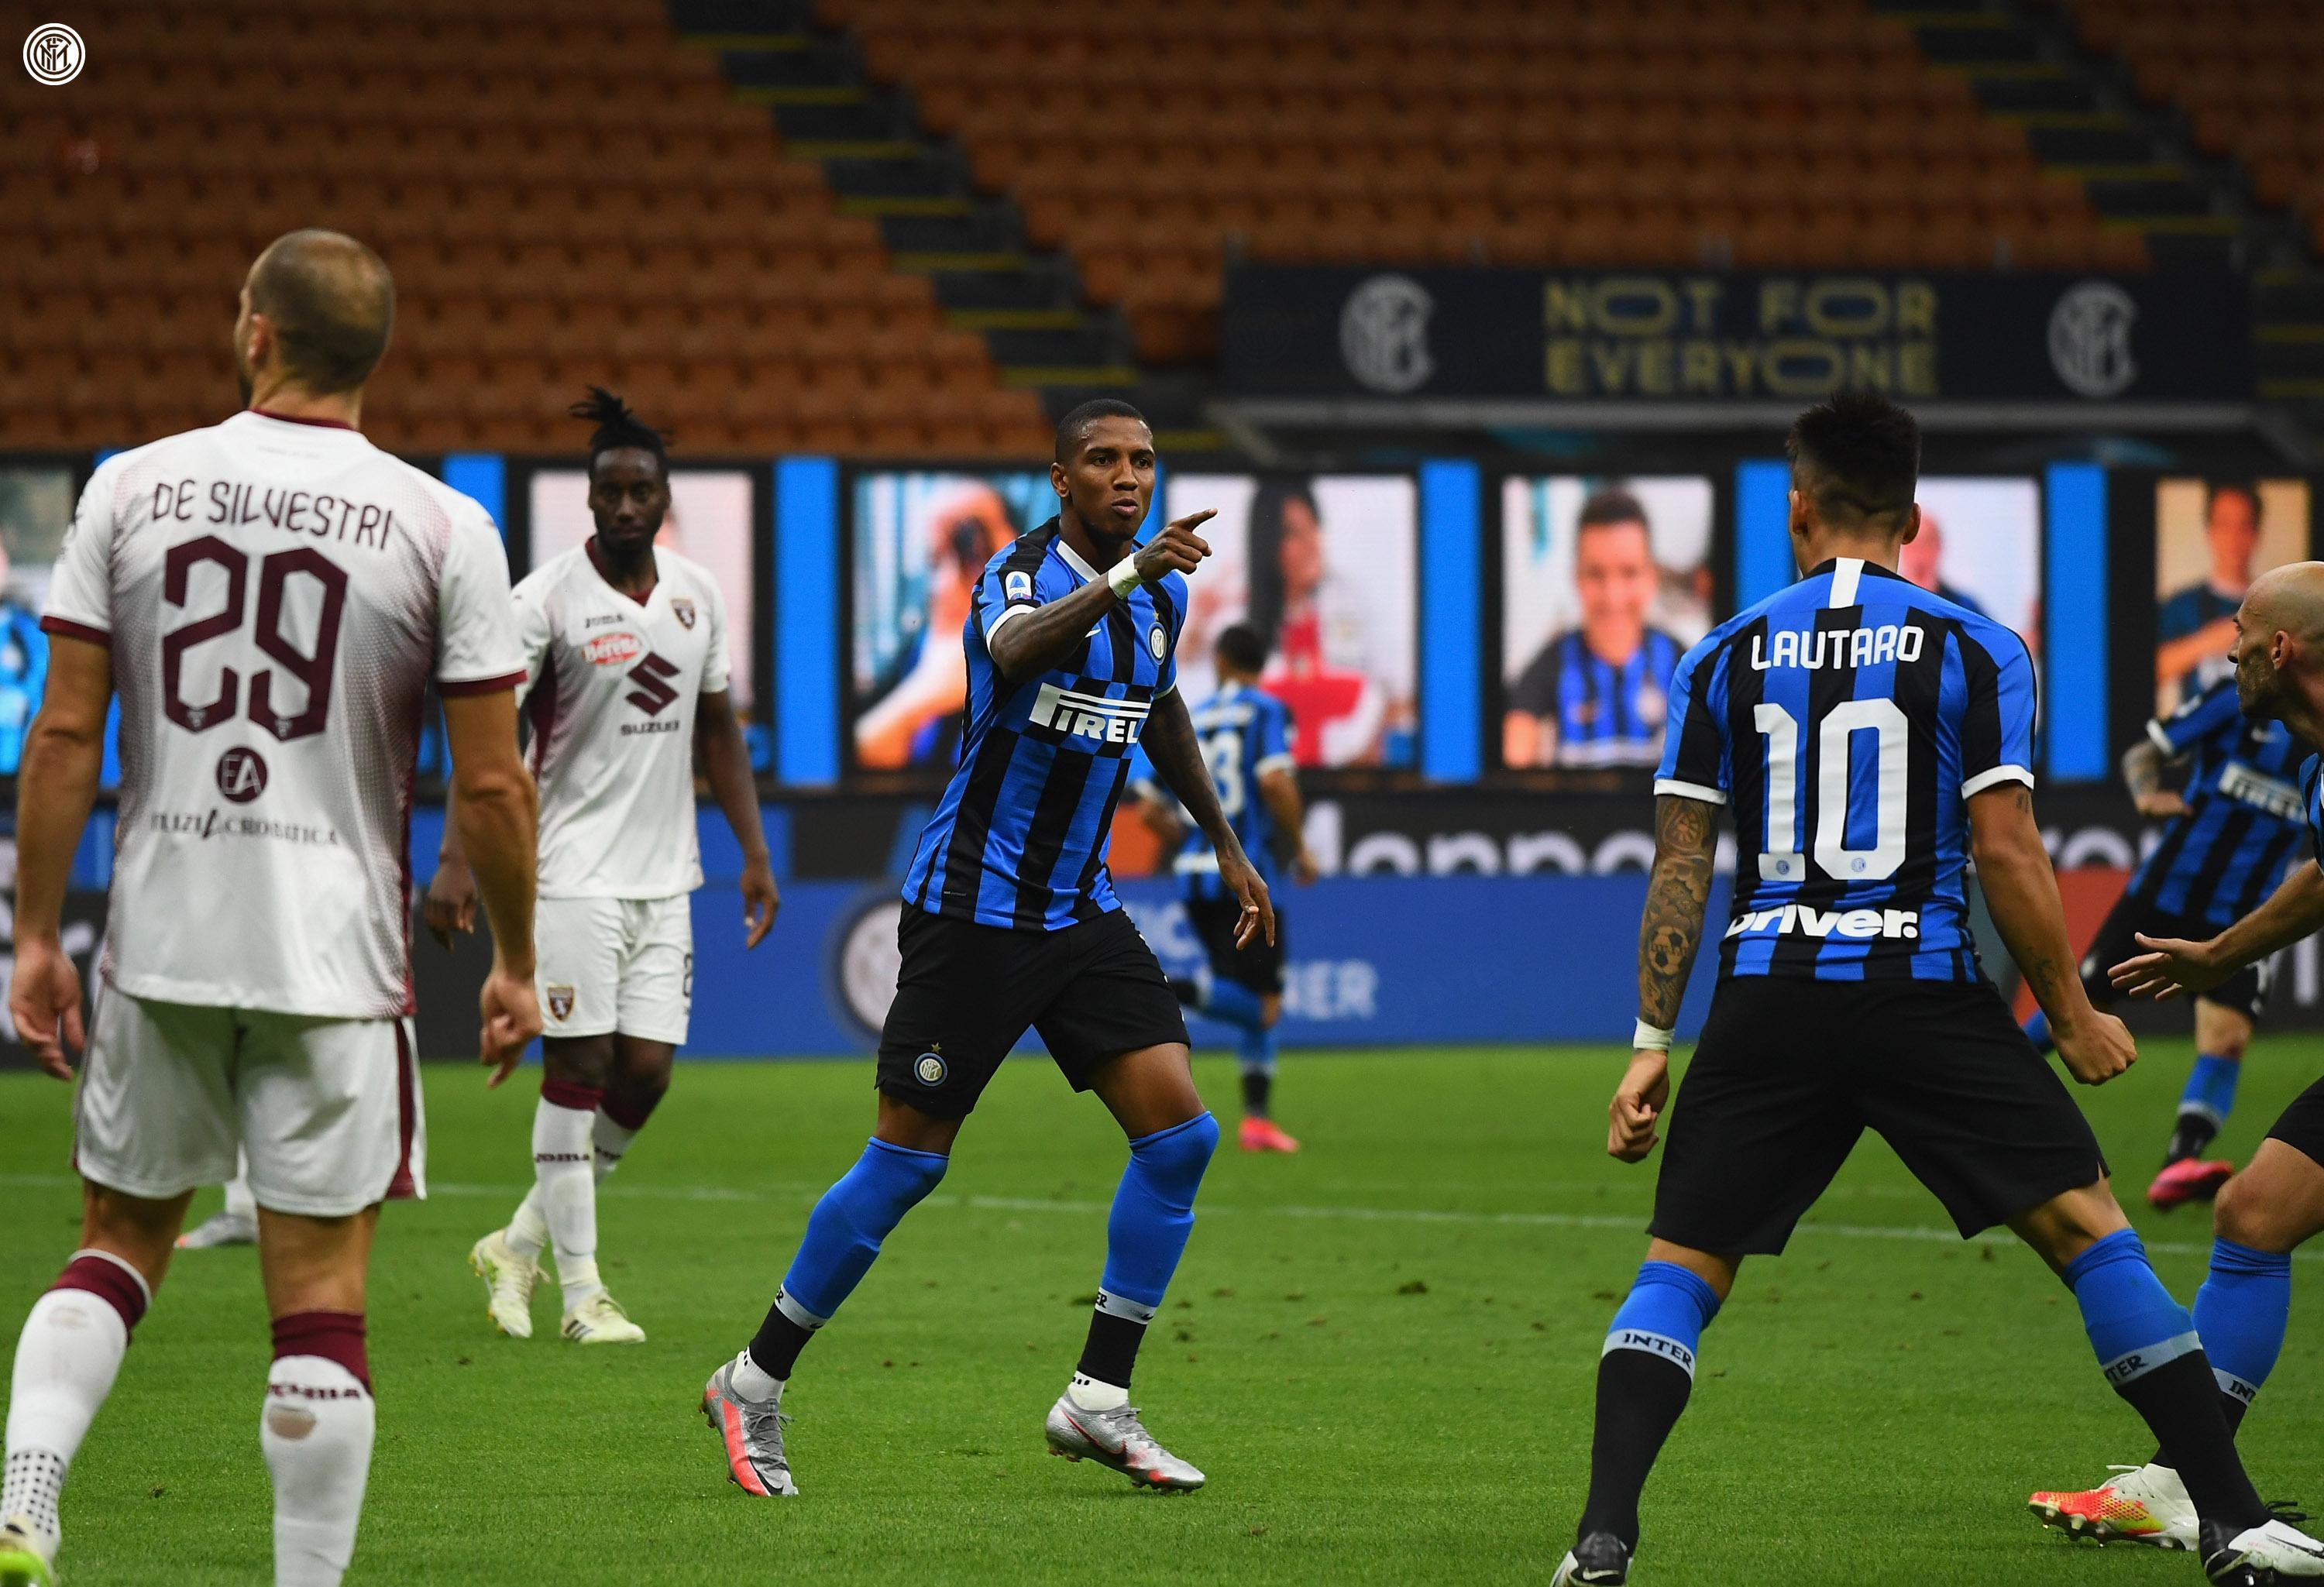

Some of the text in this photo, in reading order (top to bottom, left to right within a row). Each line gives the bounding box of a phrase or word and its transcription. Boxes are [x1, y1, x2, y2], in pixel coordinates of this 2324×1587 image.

[1545, 277, 1935, 336] NOT FOR
[1545, 338, 1935, 396] EVERYONE
[152, 479, 392, 550] DE SILVESTRI
[163, 534, 348, 741] 29
[1751, 624, 1924, 671] LAUTARO
[1754, 698, 1908, 881] 10
[1623, 1332, 1692, 1369] INTER
